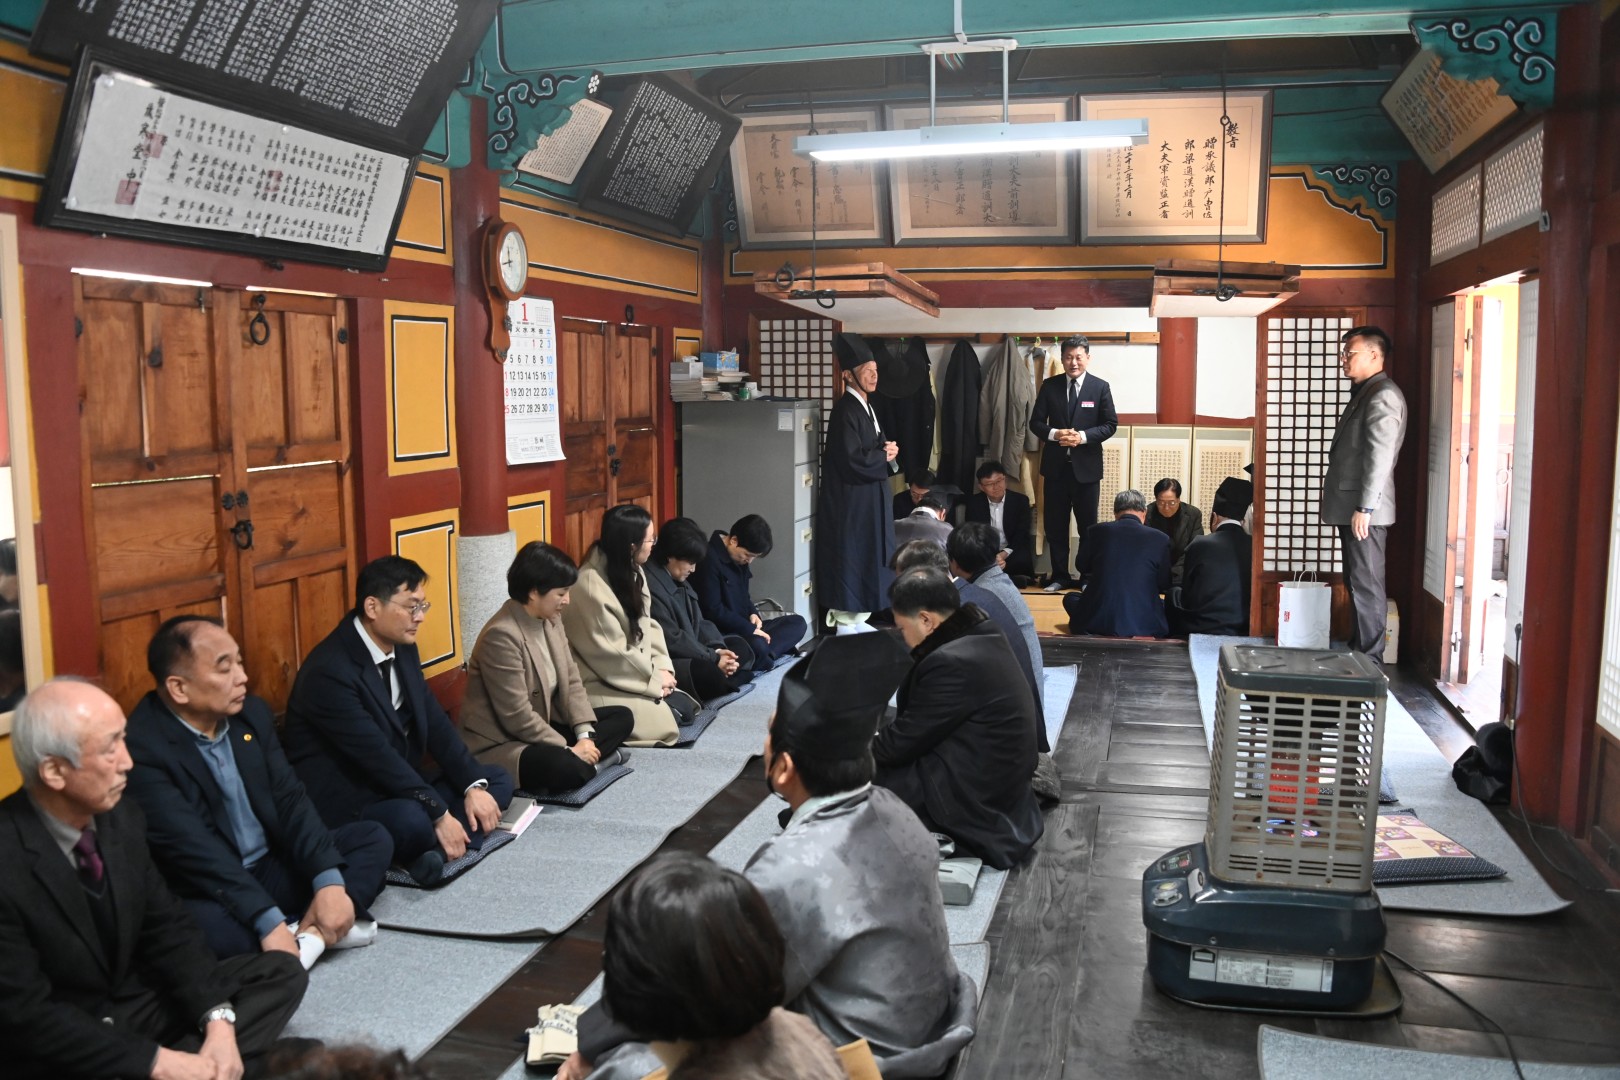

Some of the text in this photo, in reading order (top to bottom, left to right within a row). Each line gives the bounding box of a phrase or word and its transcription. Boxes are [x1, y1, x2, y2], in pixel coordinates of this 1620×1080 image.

[522, 302, 528, 321] 1
[510, 372, 516, 380] 12
[517, 372, 524, 380] 13
[525, 372, 531, 380] 14
[533, 372, 539, 380] 15
[540, 372, 546, 380] 16
[511, 388, 517, 396] 19
[518, 388, 524, 396] 20
[526, 388, 532, 396] 21
[533, 388, 540, 396] 22
[541, 388, 547, 396] 23
[511, 404, 517, 413] 26
[519, 404, 525, 413] 27
[527, 404, 533, 413] 28
[534, 404, 540, 413] 29
[542, 404, 548, 412] 30
